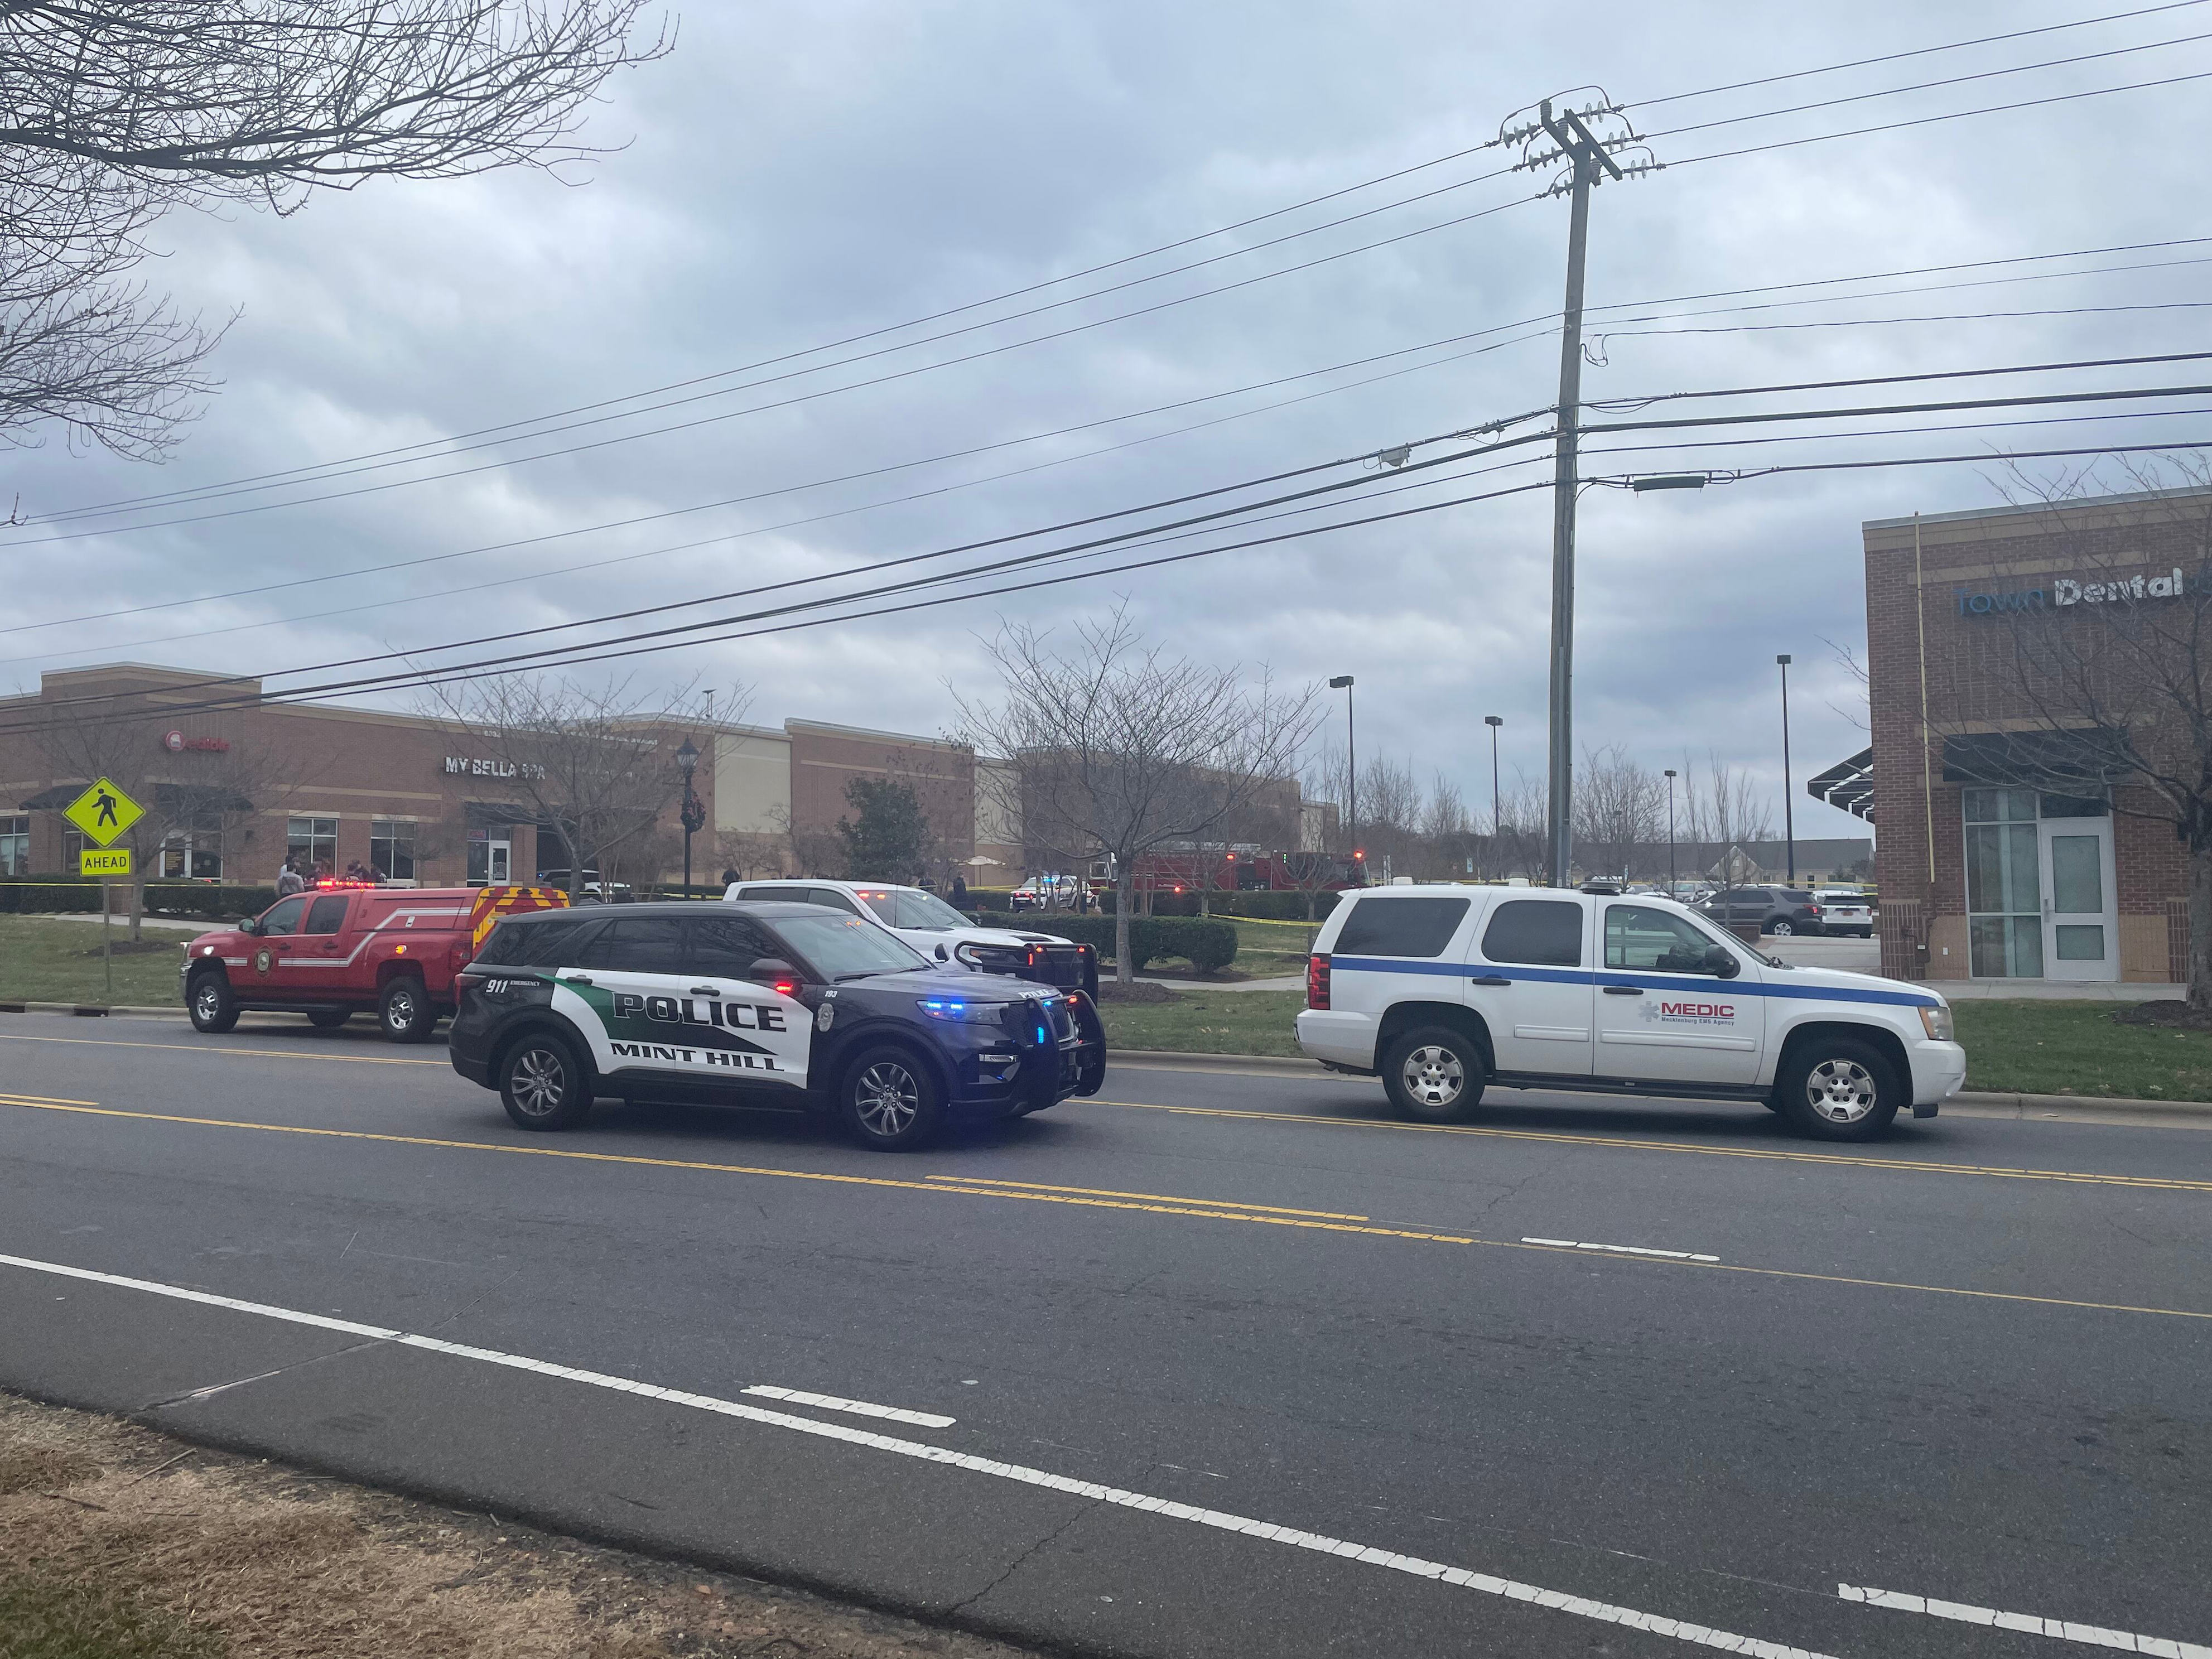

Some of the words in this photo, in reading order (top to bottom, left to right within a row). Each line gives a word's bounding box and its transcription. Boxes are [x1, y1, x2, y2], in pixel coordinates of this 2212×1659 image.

[1954, 587, 2045, 616] Town
[2054, 567, 2184, 606] Dental
[446, 756, 469, 773] MY
[472, 759, 517, 777] BELLA
[85, 856, 127, 868] AHEAD
[485, 979, 509, 993] 911
[1018, 988, 1052, 999] POLICE
[611, 992, 787, 1032] POLICE
[1661, 1002, 1734, 1017] MEDIC
[610, 1043, 697, 1062] MINT
[705, 1052, 785, 1072] HILL
